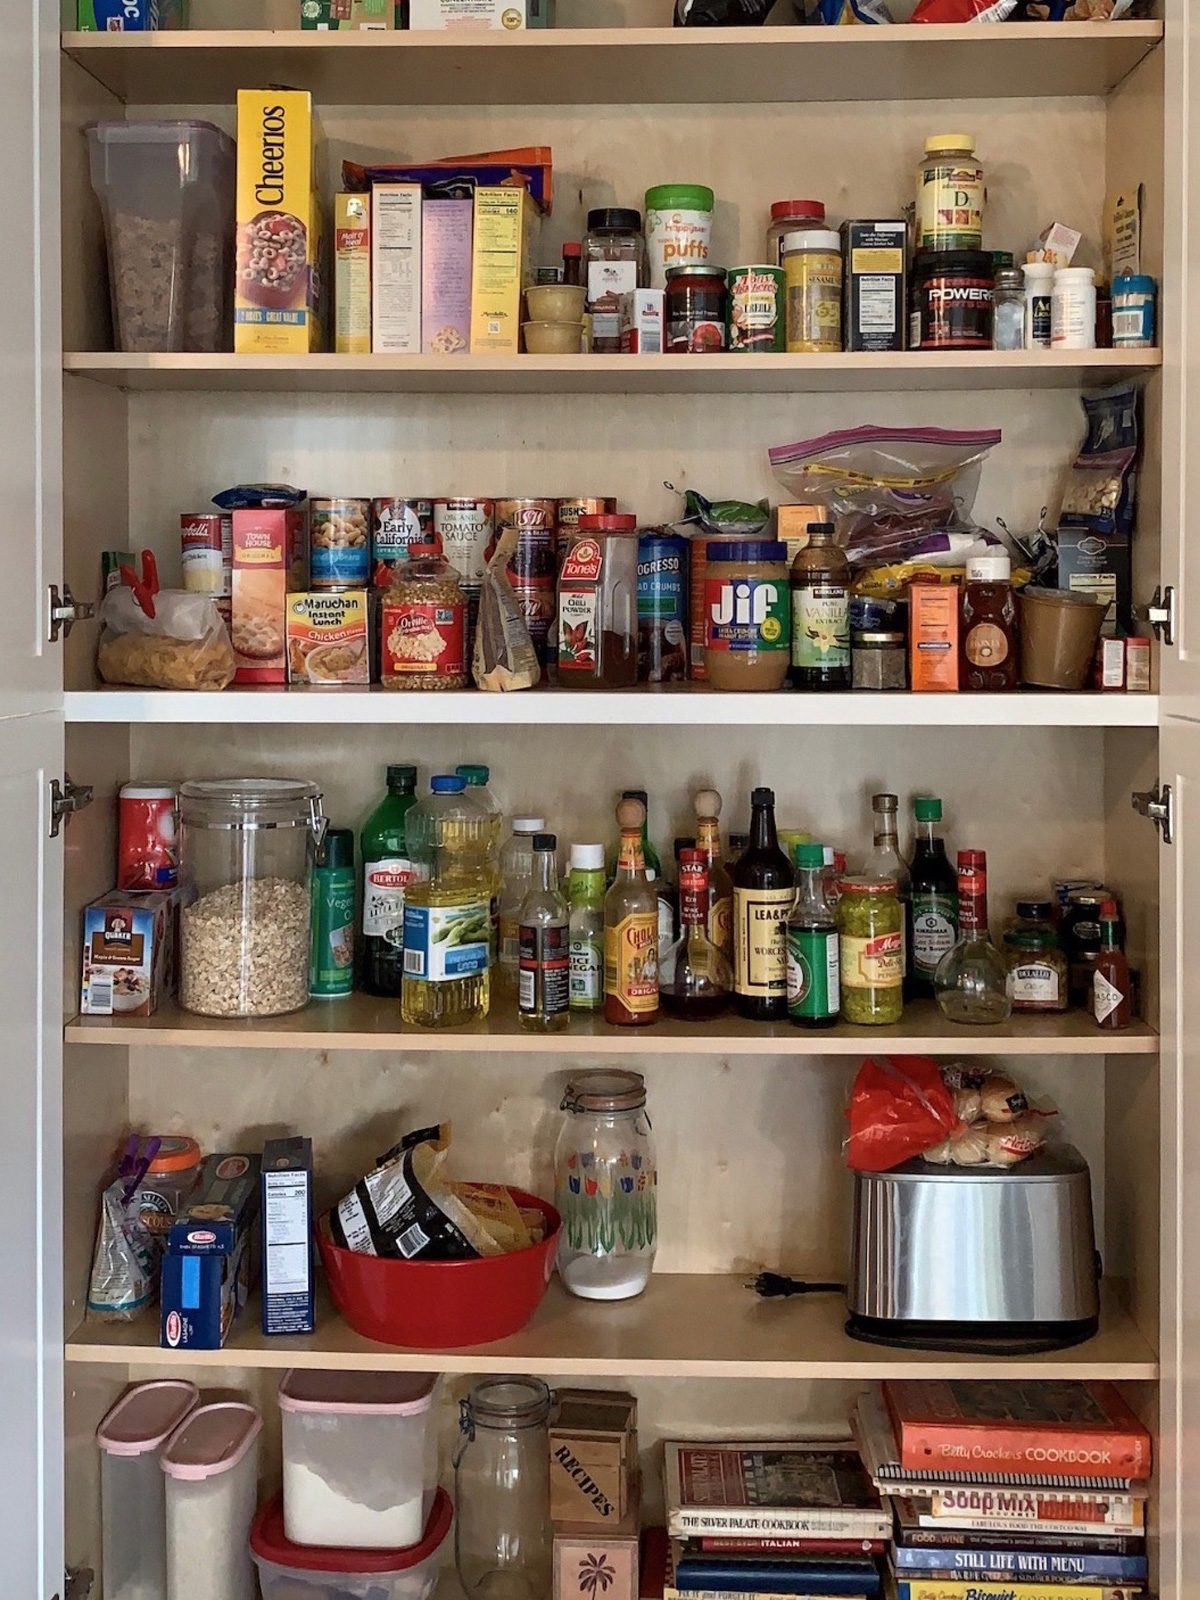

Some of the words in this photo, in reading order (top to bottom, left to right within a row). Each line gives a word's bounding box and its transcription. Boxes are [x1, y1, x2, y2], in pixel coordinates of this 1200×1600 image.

[255, 105, 285, 206] Cheerios
[663, 239, 709, 261] puffs
[560, 506, 587, 517] BUSH'S
[181, 523, 209, 538] pbell's
[383, 521, 413, 534] Early
[441, 523, 483, 532] TOMATO
[375, 532, 424, 545] California
[445, 532, 477, 541] SAUCE
[245, 540, 271, 548] HOUSE
[566, 562, 597, 575] Tone's
[637, 558, 679, 575] OGRESSO
[650, 582, 680, 592] CRUMBS
[304, 599, 358, 611] Maruchan
[712, 583, 778, 625] Jif
[308, 611, 345, 619] Instant
[401, 617, 428, 627] Orville
[308, 631, 347, 642] Chicken
[681, 864, 704, 873] STAR
[373, 875, 409, 883] BERTOL
[755, 910, 789, 920] LEA&PE
[105, 932, 131, 940] QUAKER
[1097, 993, 1117, 1001] ASCO
[938, 1444, 970, 1460] Betty
[972, 1446, 1021, 1460] Crocker's
[1025, 1448, 1111, 1464] COOKBOOK
[554, 1446, 616, 1517] RECIPES
[682, 1517, 699, 1526] THE
[700, 1517, 727, 1528] SILVER
[729, 1518, 760, 1529] PALATE
[762, 1519, 809, 1531] COOKBOOK
[912, 1533, 936, 1543] FOOD
[942, 1535, 965, 1544] WINE
[955, 1553, 986, 1568] STILL
[990, 1554, 1015, 1569] LIFE
[1018, 1555, 1047, 1570] WITH
[1051, 1556, 1085, 1572] MENU
[966, 1588, 1018, 1600] Bisquick
